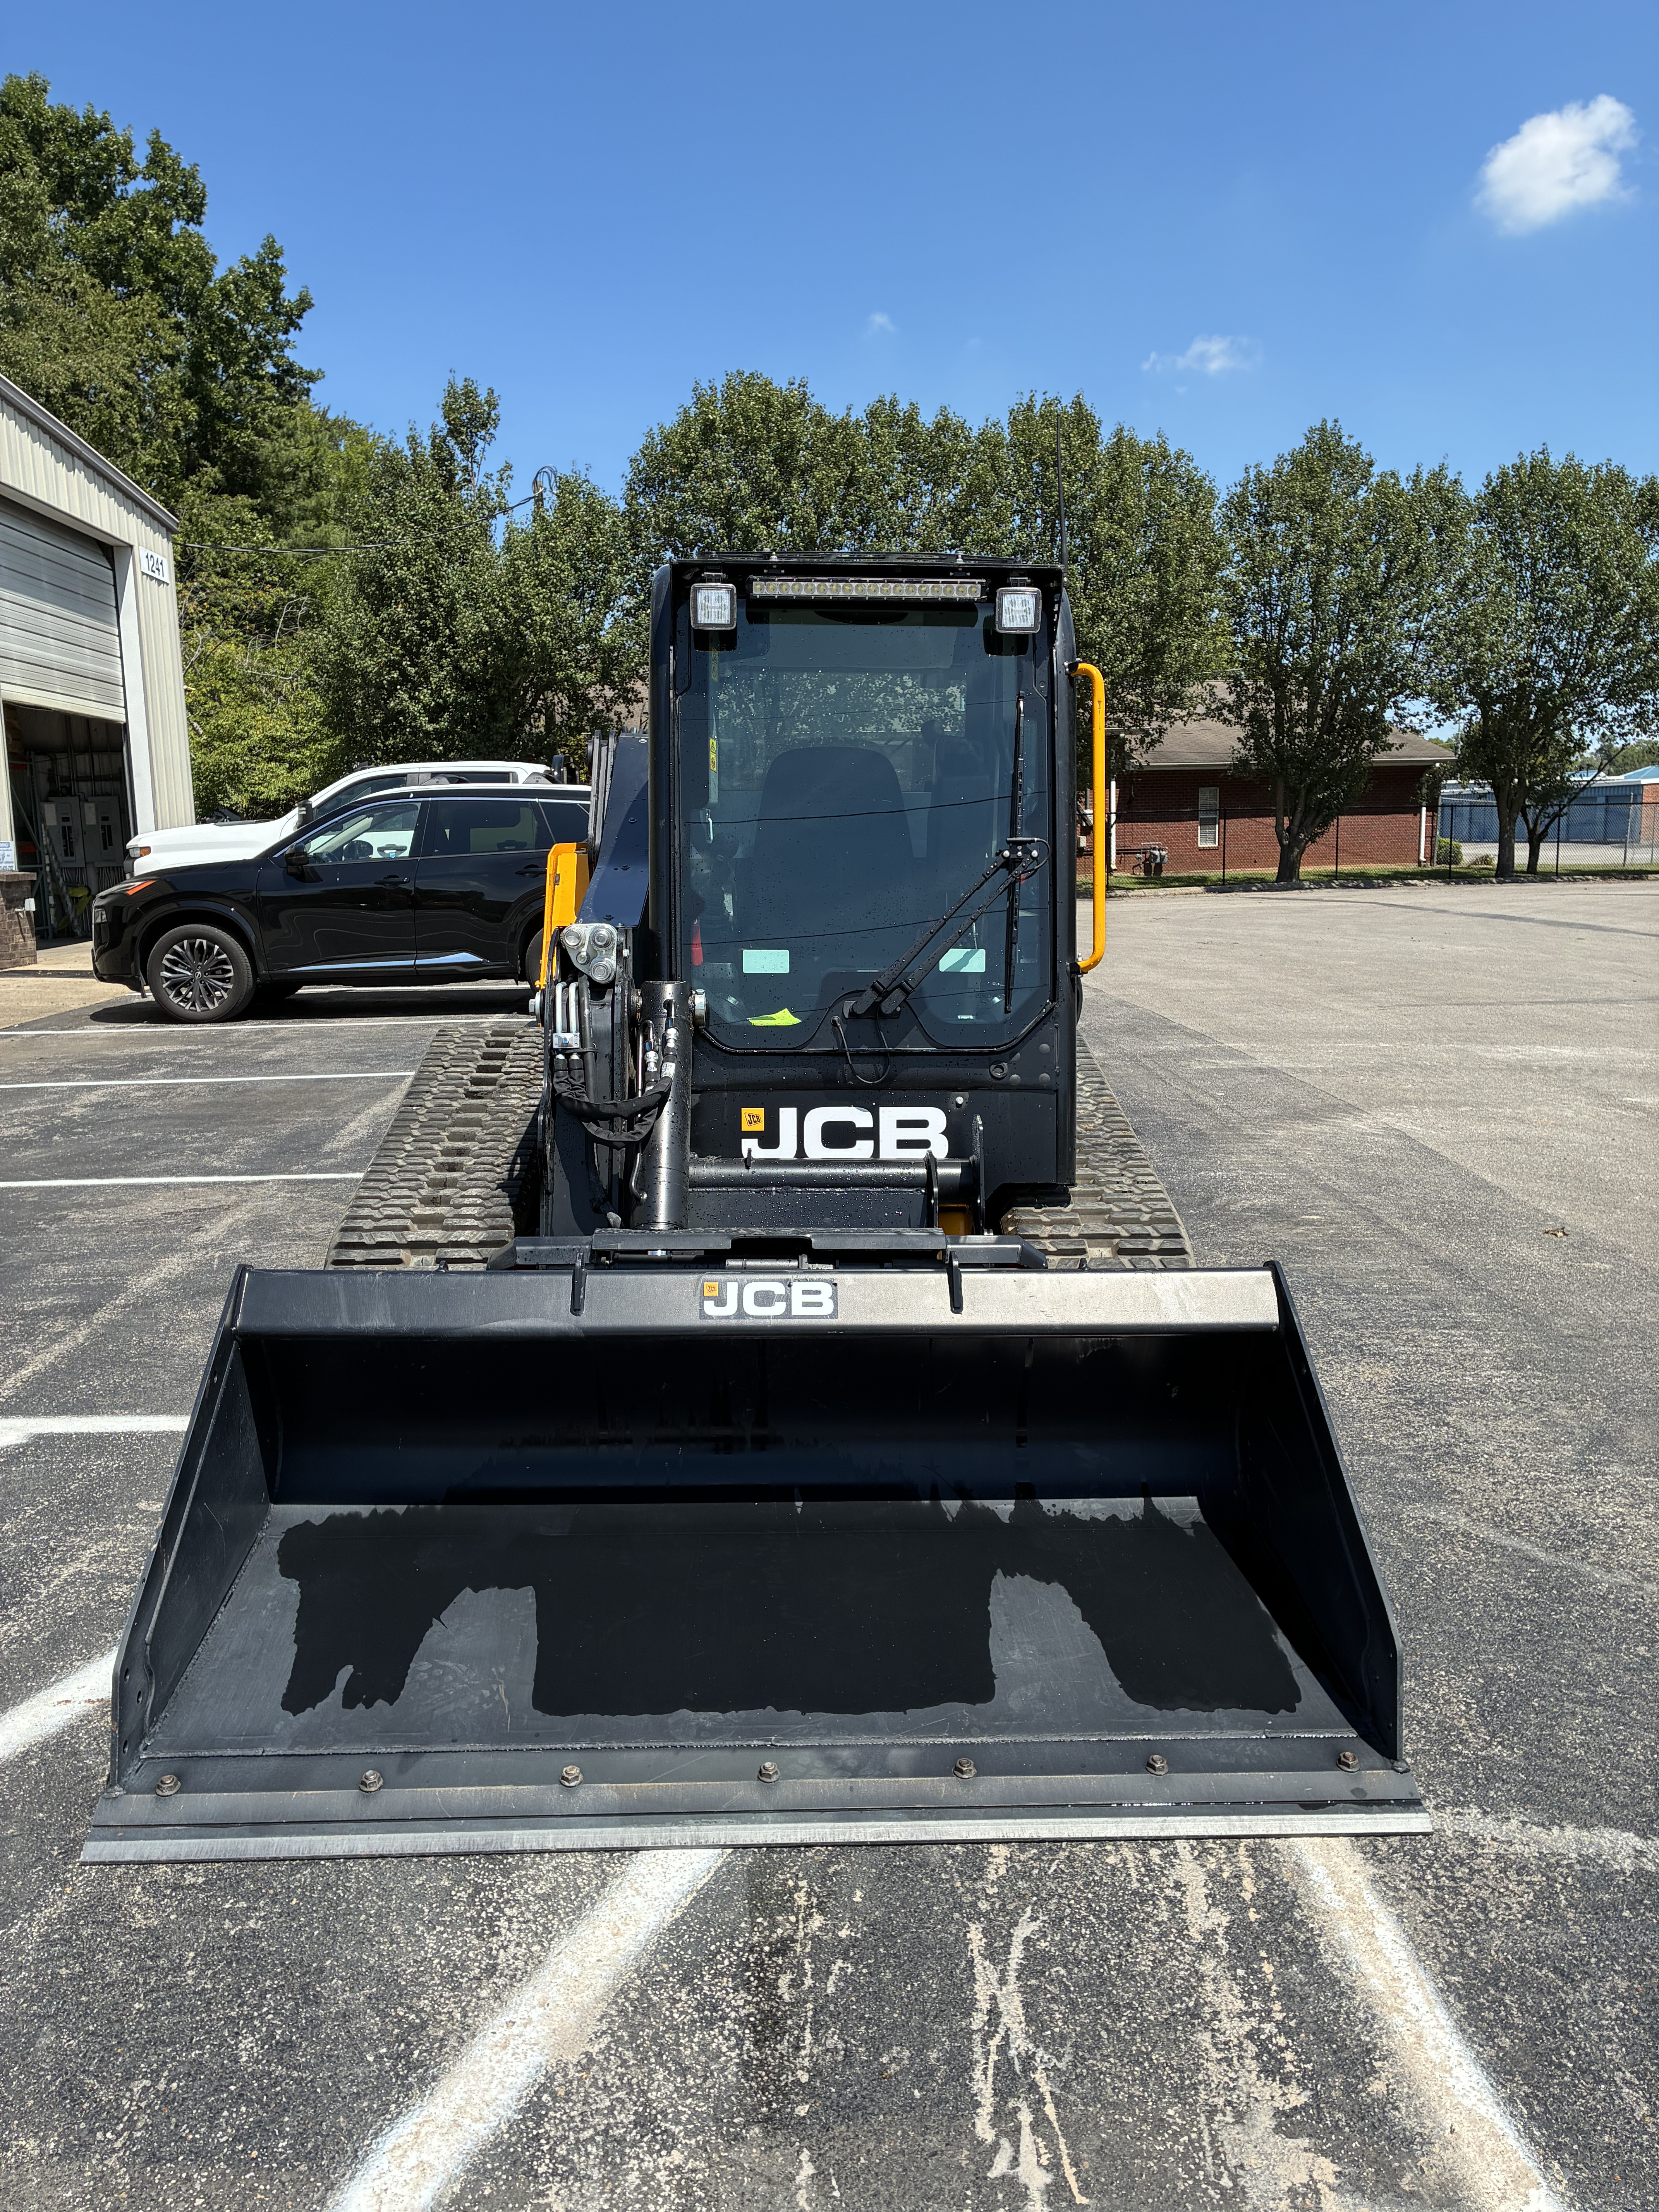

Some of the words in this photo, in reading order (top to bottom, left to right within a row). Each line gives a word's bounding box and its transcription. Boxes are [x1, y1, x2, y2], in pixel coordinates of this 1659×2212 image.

[146, 553, 164, 577] 1241
[742, 1106, 948, 1159] JCB
[747, 1114, 761, 1125] JCB
[704, 1282, 834, 1316] JCB
